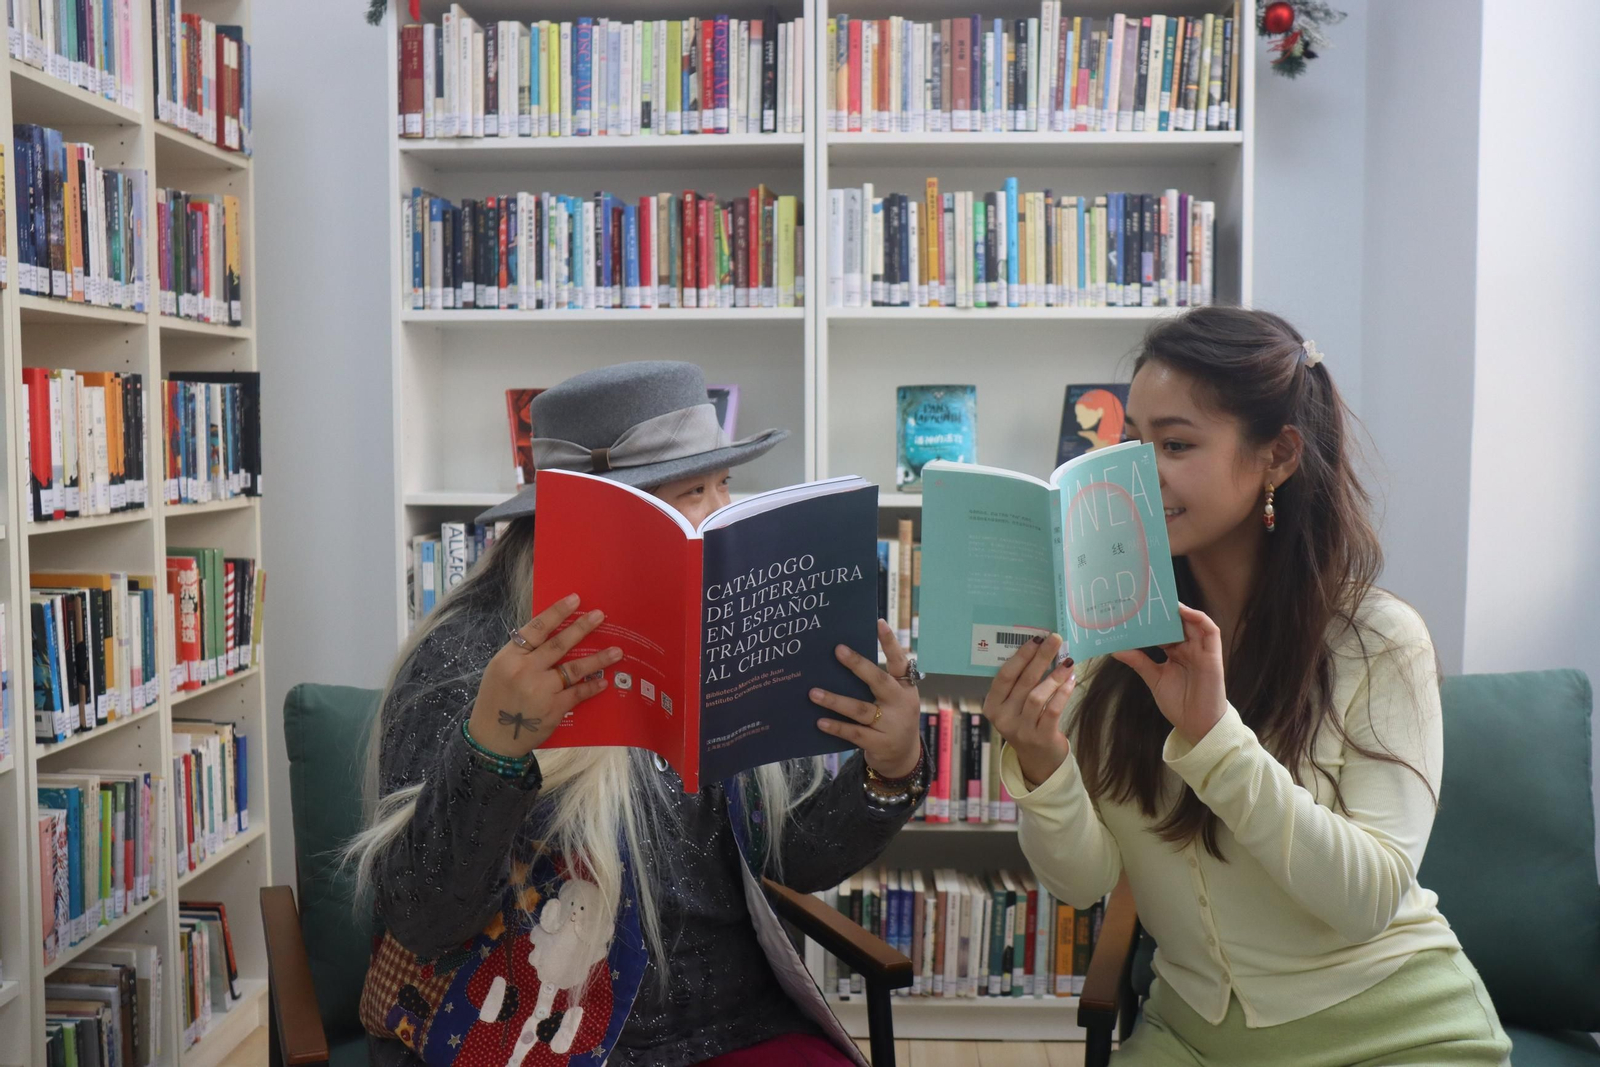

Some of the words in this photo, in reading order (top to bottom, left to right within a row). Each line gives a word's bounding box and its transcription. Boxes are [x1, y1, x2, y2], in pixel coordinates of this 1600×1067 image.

[706, 554, 815, 602] CATÁLOGO
[706, 601, 734, 624] DE
[739, 564, 864, 614] LITERATURA
[705, 614, 822, 663] TRADUCIDA
[706, 622, 735, 644] EN
[741, 592, 830, 633] ESPAÑOL
[705, 664, 732, 684] AL
[738, 638, 801, 674] CHINO
[705, 686, 738, 700] Biblioteca
[738, 675, 760, 689] Marcela
[760, 671, 769, 679] de
[769, 668, 784, 677] Juan
[705, 696, 734, 708] Instituto
[734, 683, 762, 699] Cervantes
[763, 679, 772, 687] de
